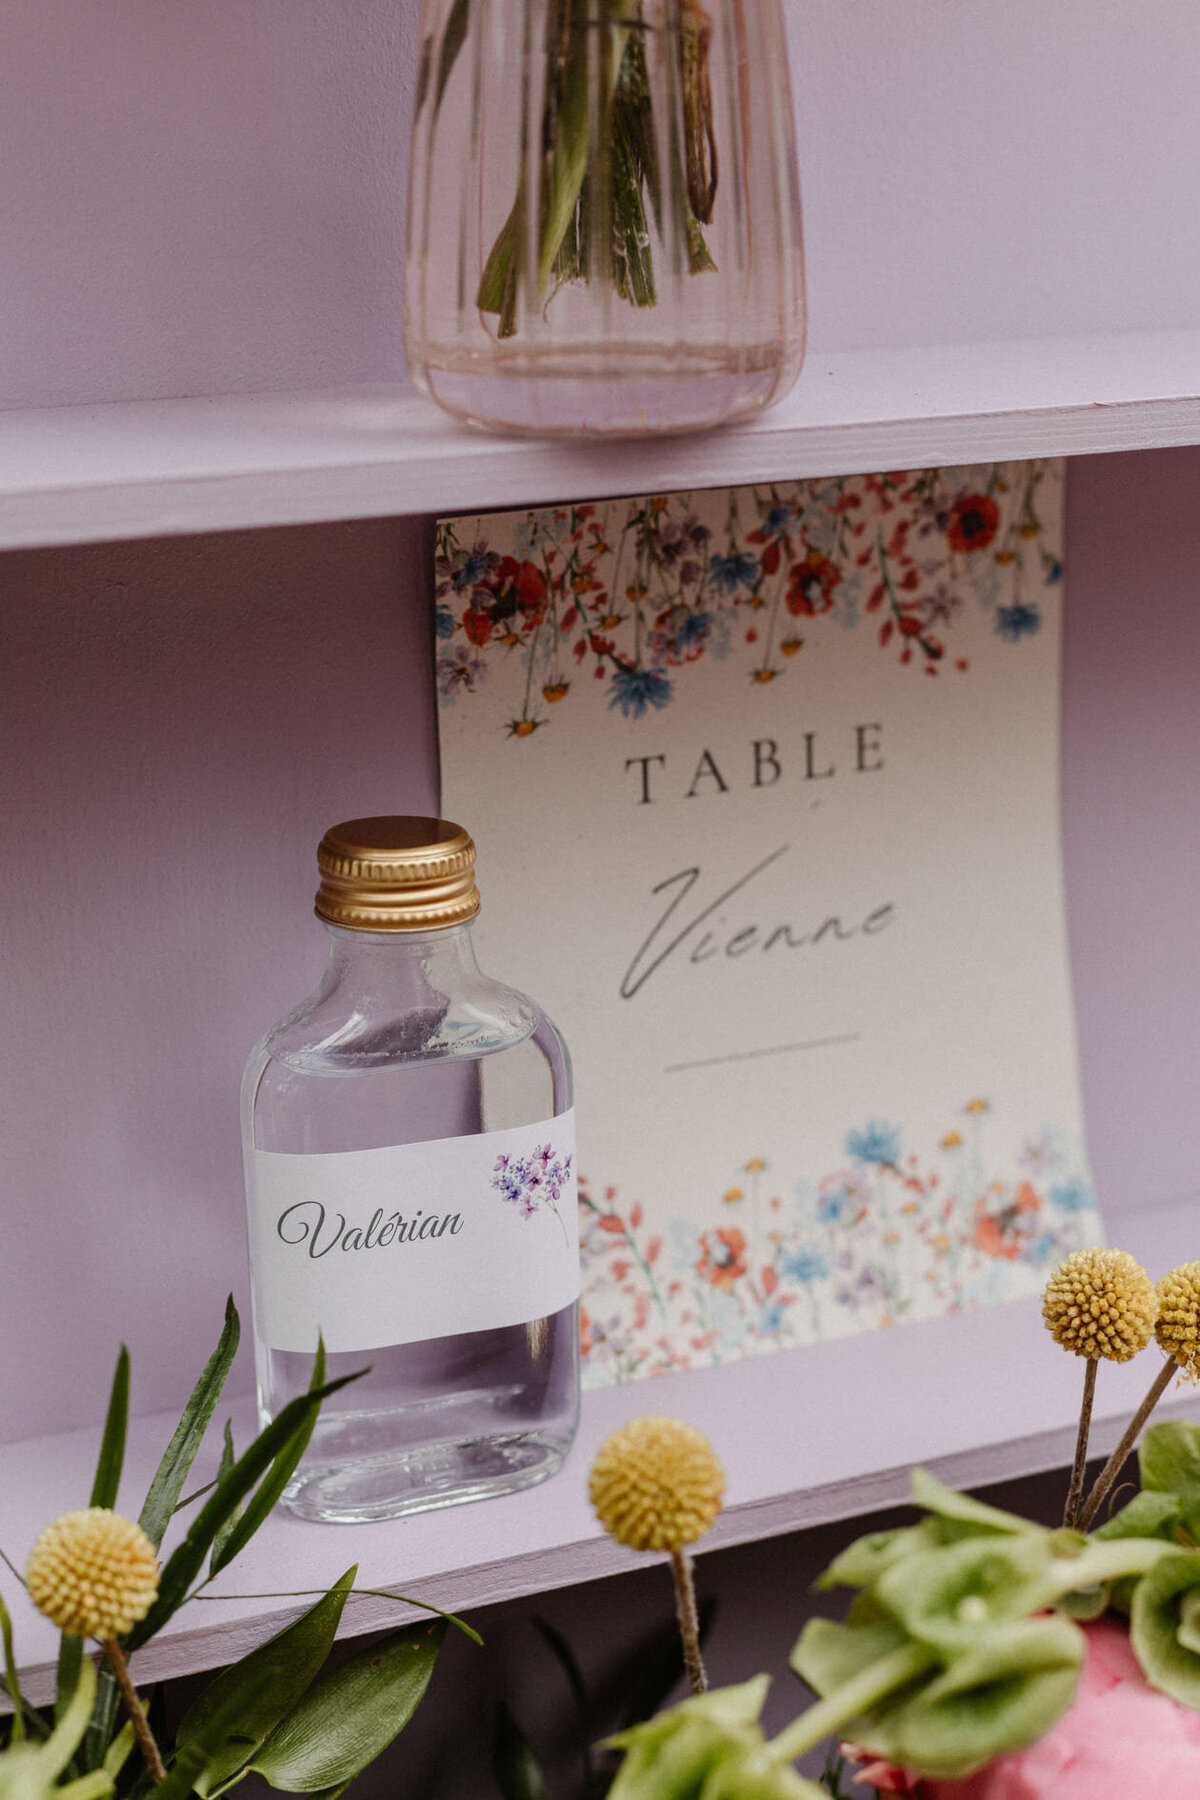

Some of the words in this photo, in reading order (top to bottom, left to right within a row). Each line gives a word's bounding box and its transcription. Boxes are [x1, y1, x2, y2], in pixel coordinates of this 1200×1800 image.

[625, 723, 885, 804] TABLE
[620, 845, 893, 999] Vienne
[277, 1201, 464, 1259] Valérian
